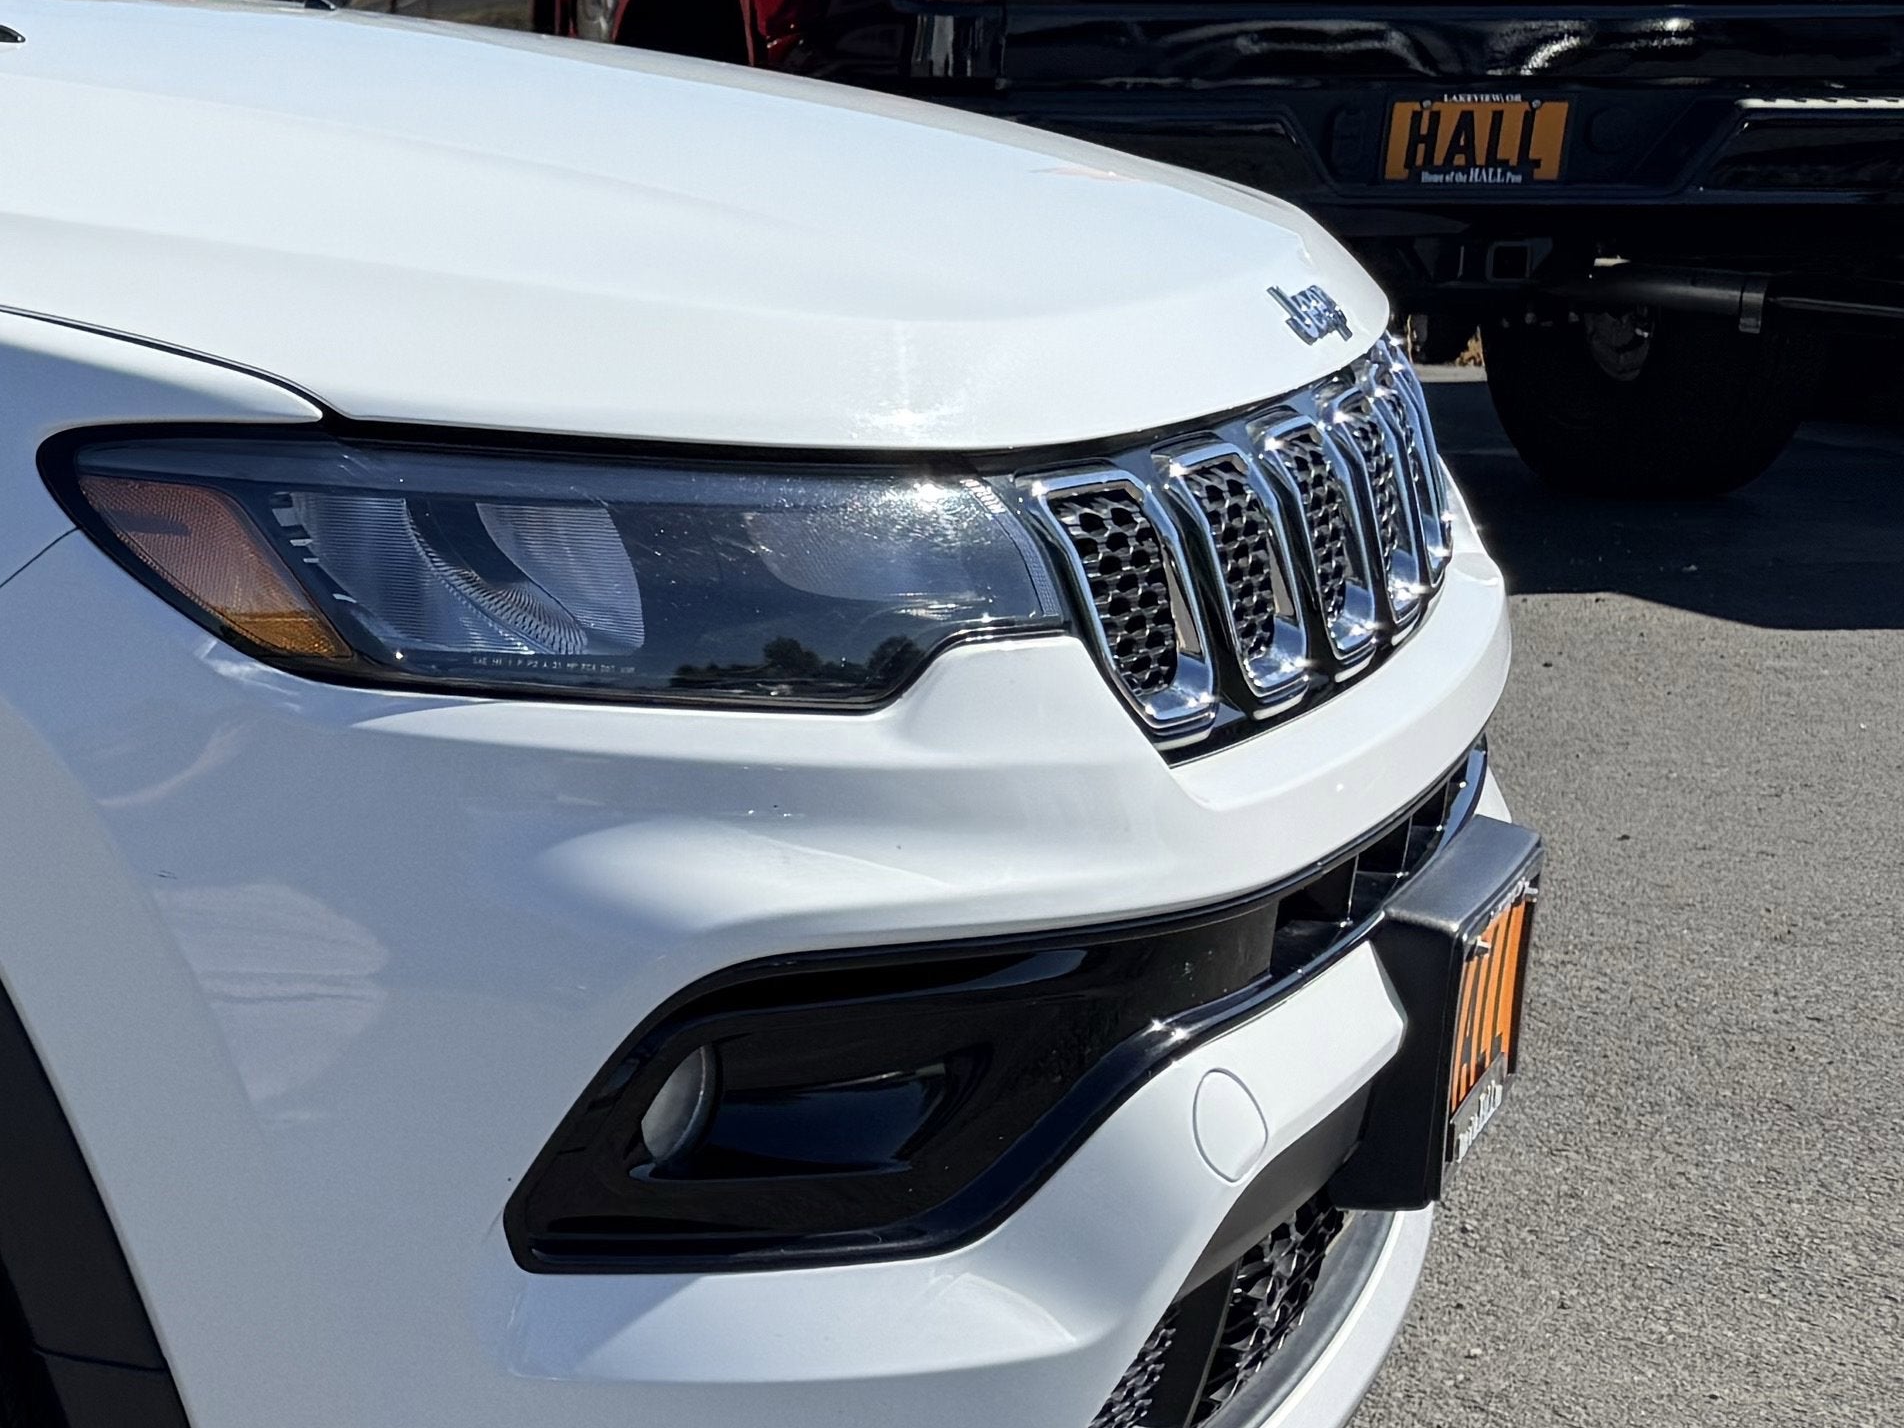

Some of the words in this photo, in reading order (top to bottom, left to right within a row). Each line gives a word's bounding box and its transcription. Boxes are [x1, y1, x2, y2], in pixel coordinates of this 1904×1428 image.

[1404, 109, 1543, 169] HALL
[1468, 167, 1505, 183] HALL
[1265, 284, 1353, 346] Jeep
